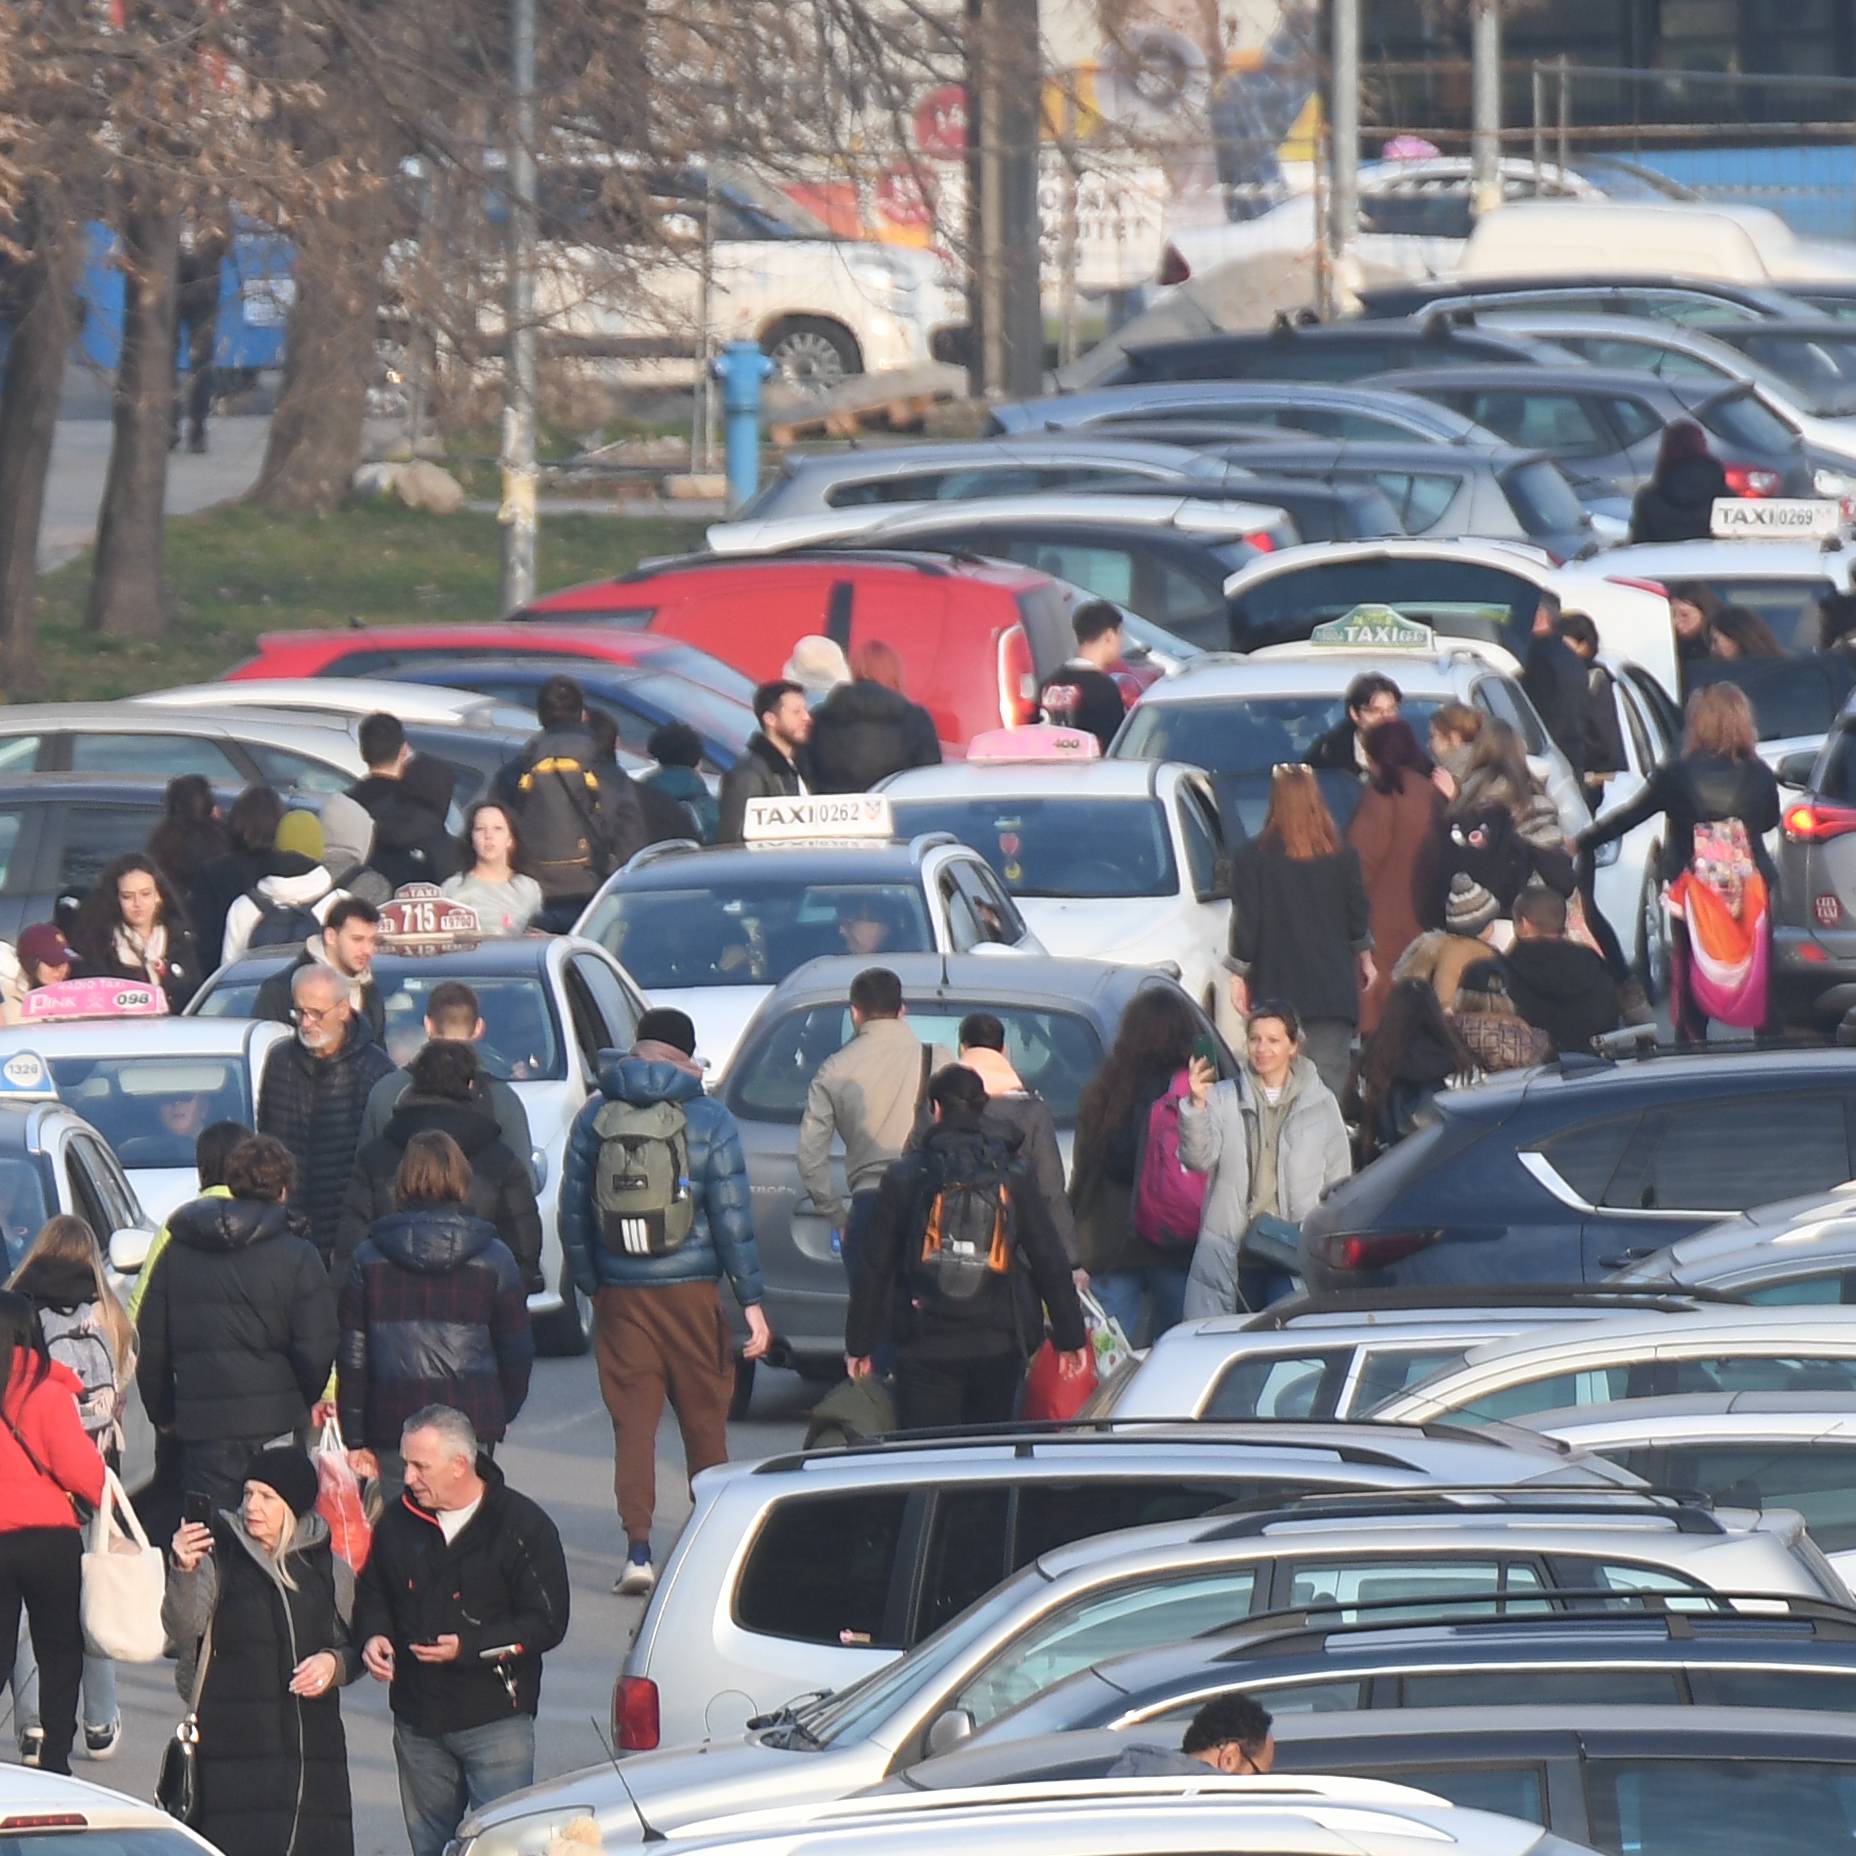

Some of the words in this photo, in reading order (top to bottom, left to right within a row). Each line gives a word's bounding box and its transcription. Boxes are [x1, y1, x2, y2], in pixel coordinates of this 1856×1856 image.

[1719, 508, 1774, 524] TAXI
[1344, 625, 1398, 642] TAXI
[752, 806, 814, 825] TAXI
[819, 802, 859, 823] 0262
[410, 887, 438, 897] TAXI
[401, 902, 435, 932] 715
